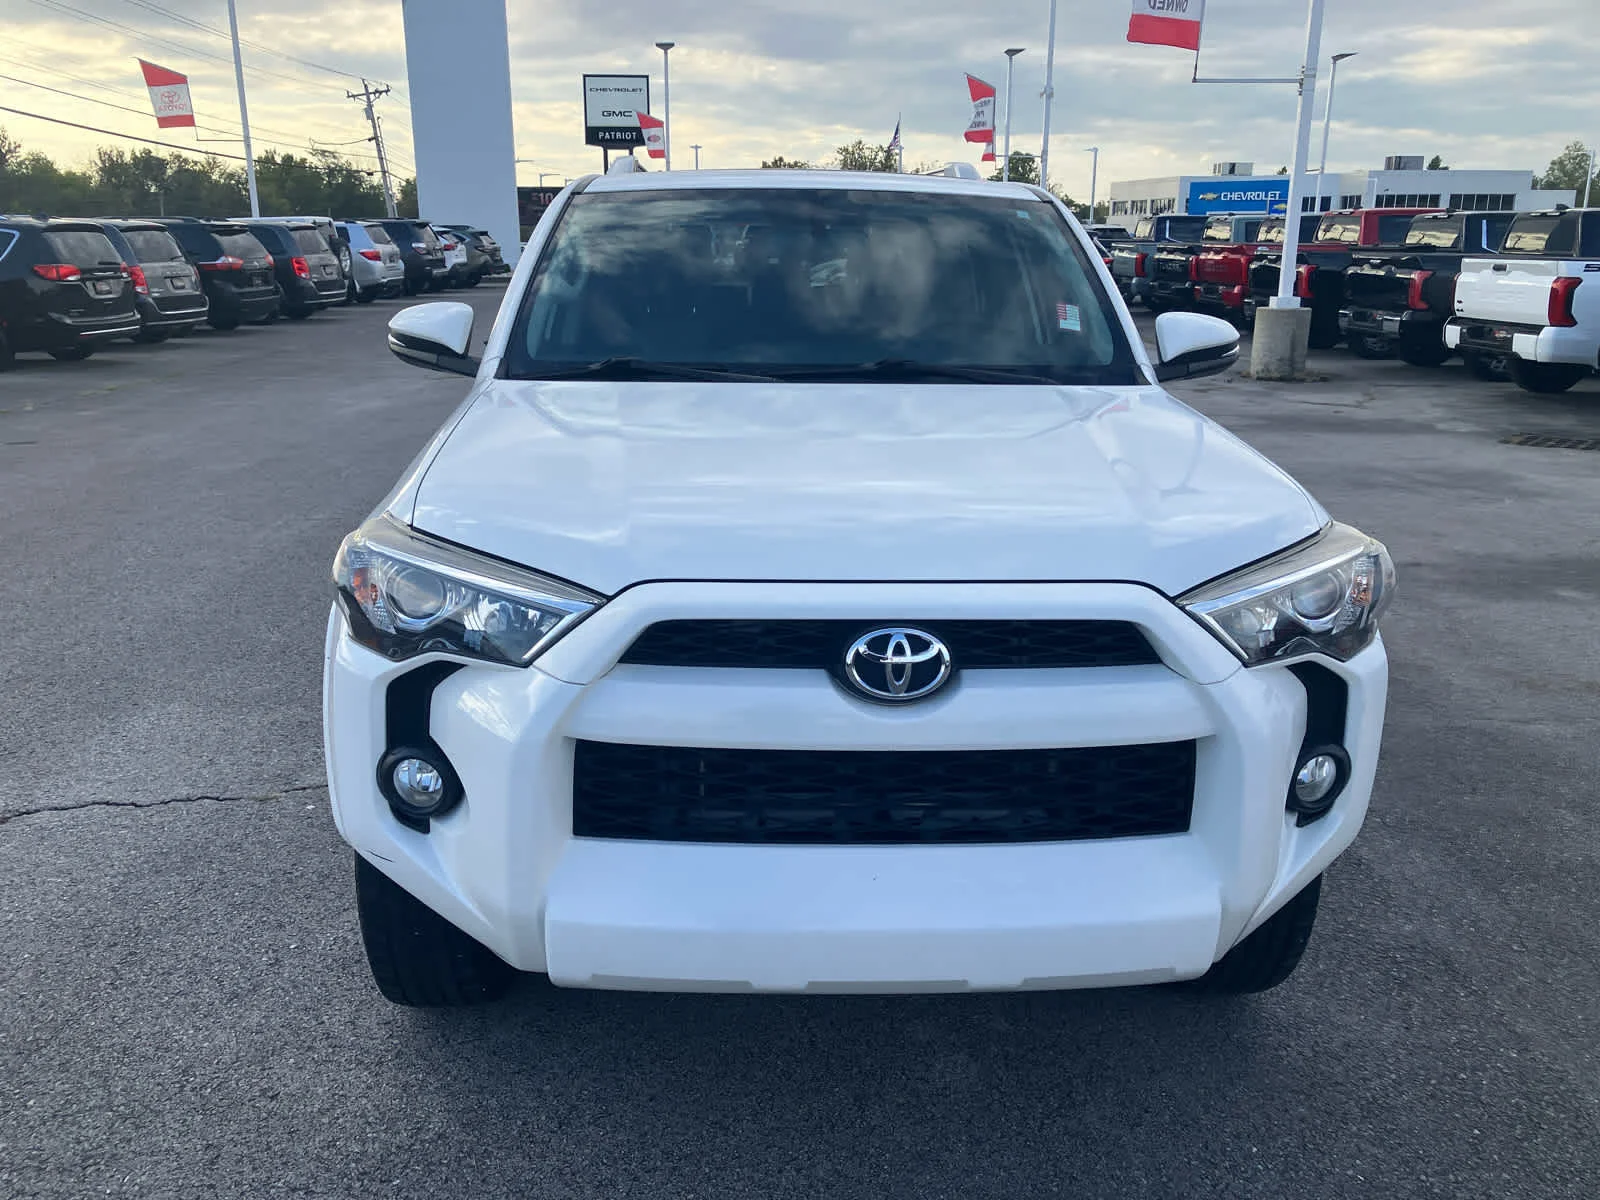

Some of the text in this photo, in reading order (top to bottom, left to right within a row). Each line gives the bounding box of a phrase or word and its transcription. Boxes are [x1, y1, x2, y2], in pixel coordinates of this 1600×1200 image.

[601, 110, 632, 118] GMC
[598, 132, 637, 140] PATRIOT
[1220, 190, 1281, 201] CHEVROLET
